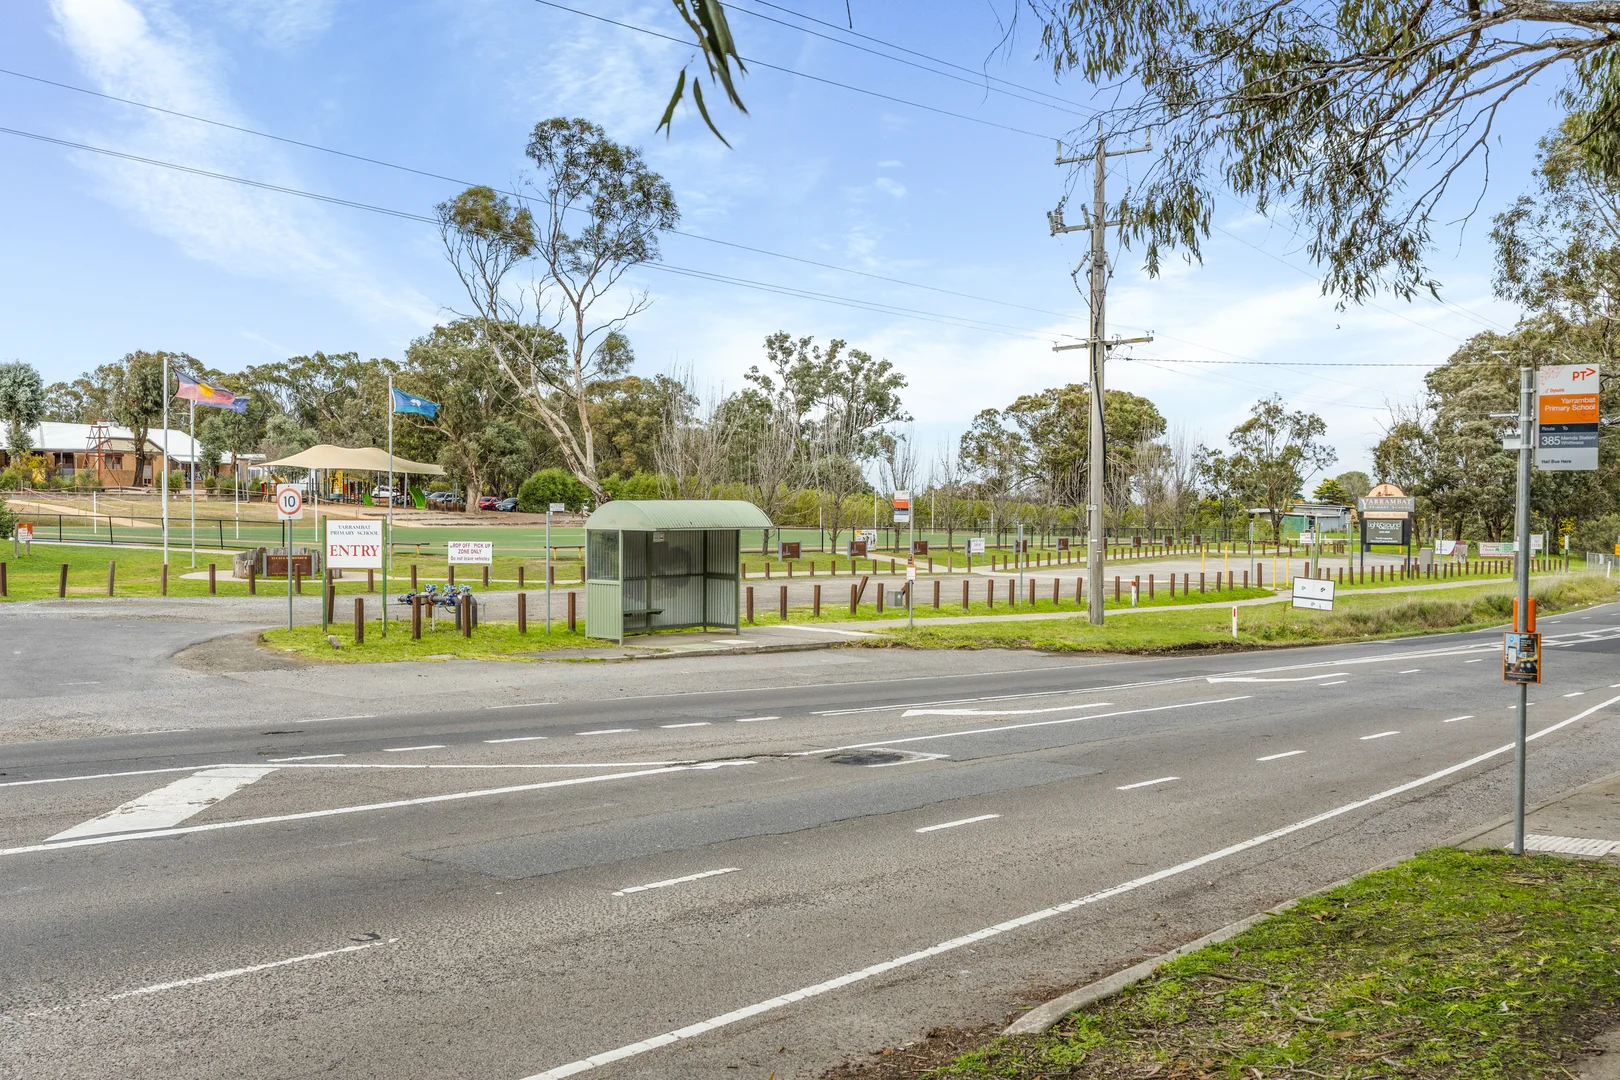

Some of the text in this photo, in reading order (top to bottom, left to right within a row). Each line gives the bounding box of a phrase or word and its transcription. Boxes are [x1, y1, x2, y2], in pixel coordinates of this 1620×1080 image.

[1542, 436, 1560, 445] 385
[284, 496, 296, 507] 10
[1361, 499, 1410, 509] YARRAMBAT
[330, 545, 380, 556] ENTRY
